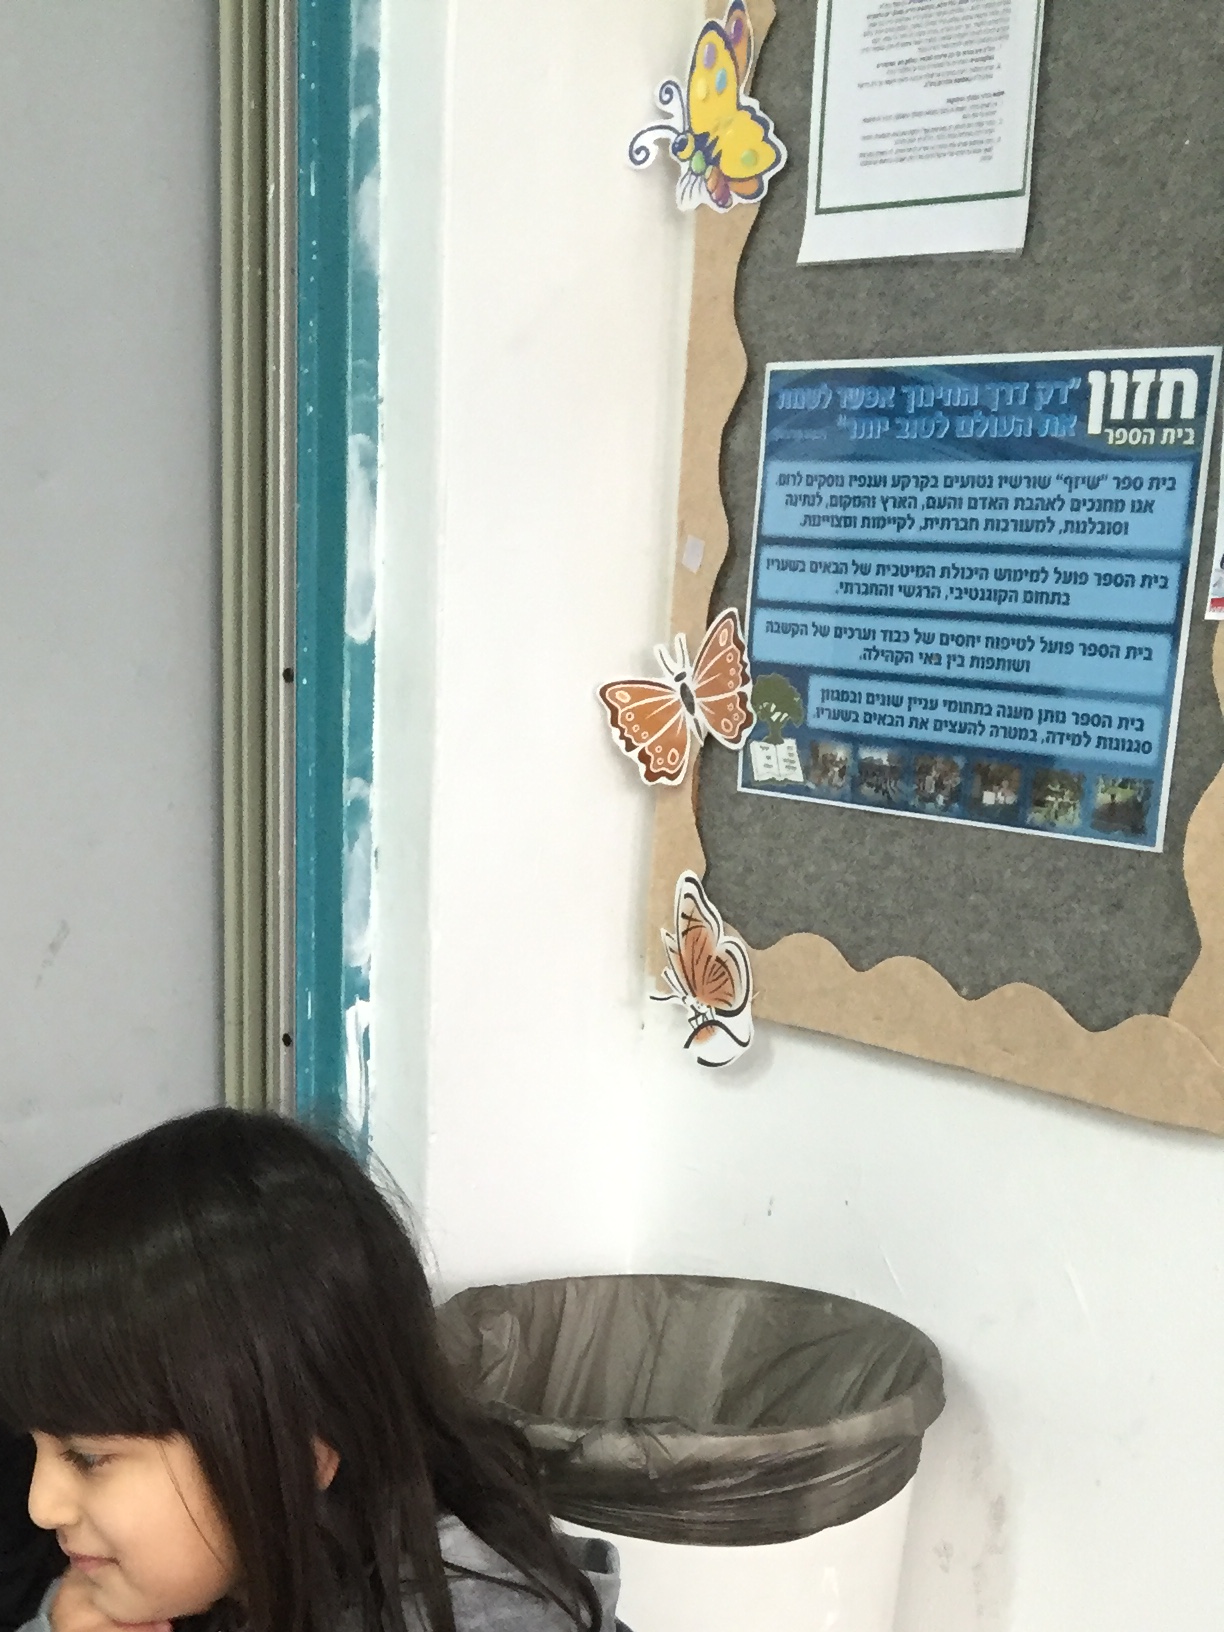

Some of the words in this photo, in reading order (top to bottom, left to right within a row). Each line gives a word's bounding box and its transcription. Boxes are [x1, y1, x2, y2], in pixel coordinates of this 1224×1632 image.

[1087, 368, 1199, 435] חזון
[895, 410, 950, 439] לטוב
[956, 410, 1032, 438] העולם
[1038, 414, 1077, 437] את
[1104, 427, 1156, 445] הספר
[1160, 428, 1195, 446] בית
[849, 473, 887, 489] וענפיו
[891, 474, 939, 492] בקרקע
[944, 474, 993, 490] נטועים
[998, 474, 1052, 490] שורשיו
[1112, 476, 1144, 491] ספר
[1148, 475, 1177, 491] בית
[880, 495, 918, 512] הארץ
[968, 495, 1009, 511] האדם
[1014, 494, 1065, 512] לאהבת
[1070, 498, 1125, 514] מחנכים
[1130, 499, 1156, 514] אנו
[860, 514, 915, 533] לקיימות
[983, 515, 1056, 533] למעורבות
[810, 559, 849, 575] הבאים
[851, 559, 872, 576] של
[875, 562, 936, 579] המיטבית
[939, 563, 990, 582] היכולת
[994, 566, 1049, 584] למימוש
[1054, 566, 1089, 586] פועל
[1094, 571, 1136, 589] הספר
[1140, 573, 1169, 590] בית
[898, 583, 942, 600] הרגשי
[1023, 589, 1071, 606] בתחום
[766, 620, 809, 639] הקשבה
[812, 621, 831, 638] של
[834, 625, 876, 642] וערכים
[880, 629, 910, 645] כבוד
[914, 628, 936, 645] של
[939, 632, 982, 650] יחסים
[984, 635, 1035, 652] לטיפוח
[1040, 636, 1074, 656] פועל
[1079, 642, 1121, 659] הספר
[1125, 644, 1153, 661] בית
[946, 653, 965, 671] בין
[969, 654, 1031, 673] ושותפות
[866, 692, 904, 708] שונים
[907, 695, 940, 713] עניין
[943, 698, 993, 717] בתחומי
[863, 712, 905, 729] הבאים
[996, 704, 1034, 721] מענה
[1037, 708, 1067, 726] נותן
[1072, 711, 1113, 729] הספר
[908, 716, 930, 731] את
[933, 718, 986, 736] להעצים
[1117, 716, 1145, 733] בית
[989, 724, 1038, 743] במטרה
[1096, 735, 1153, 755] סגנונות
